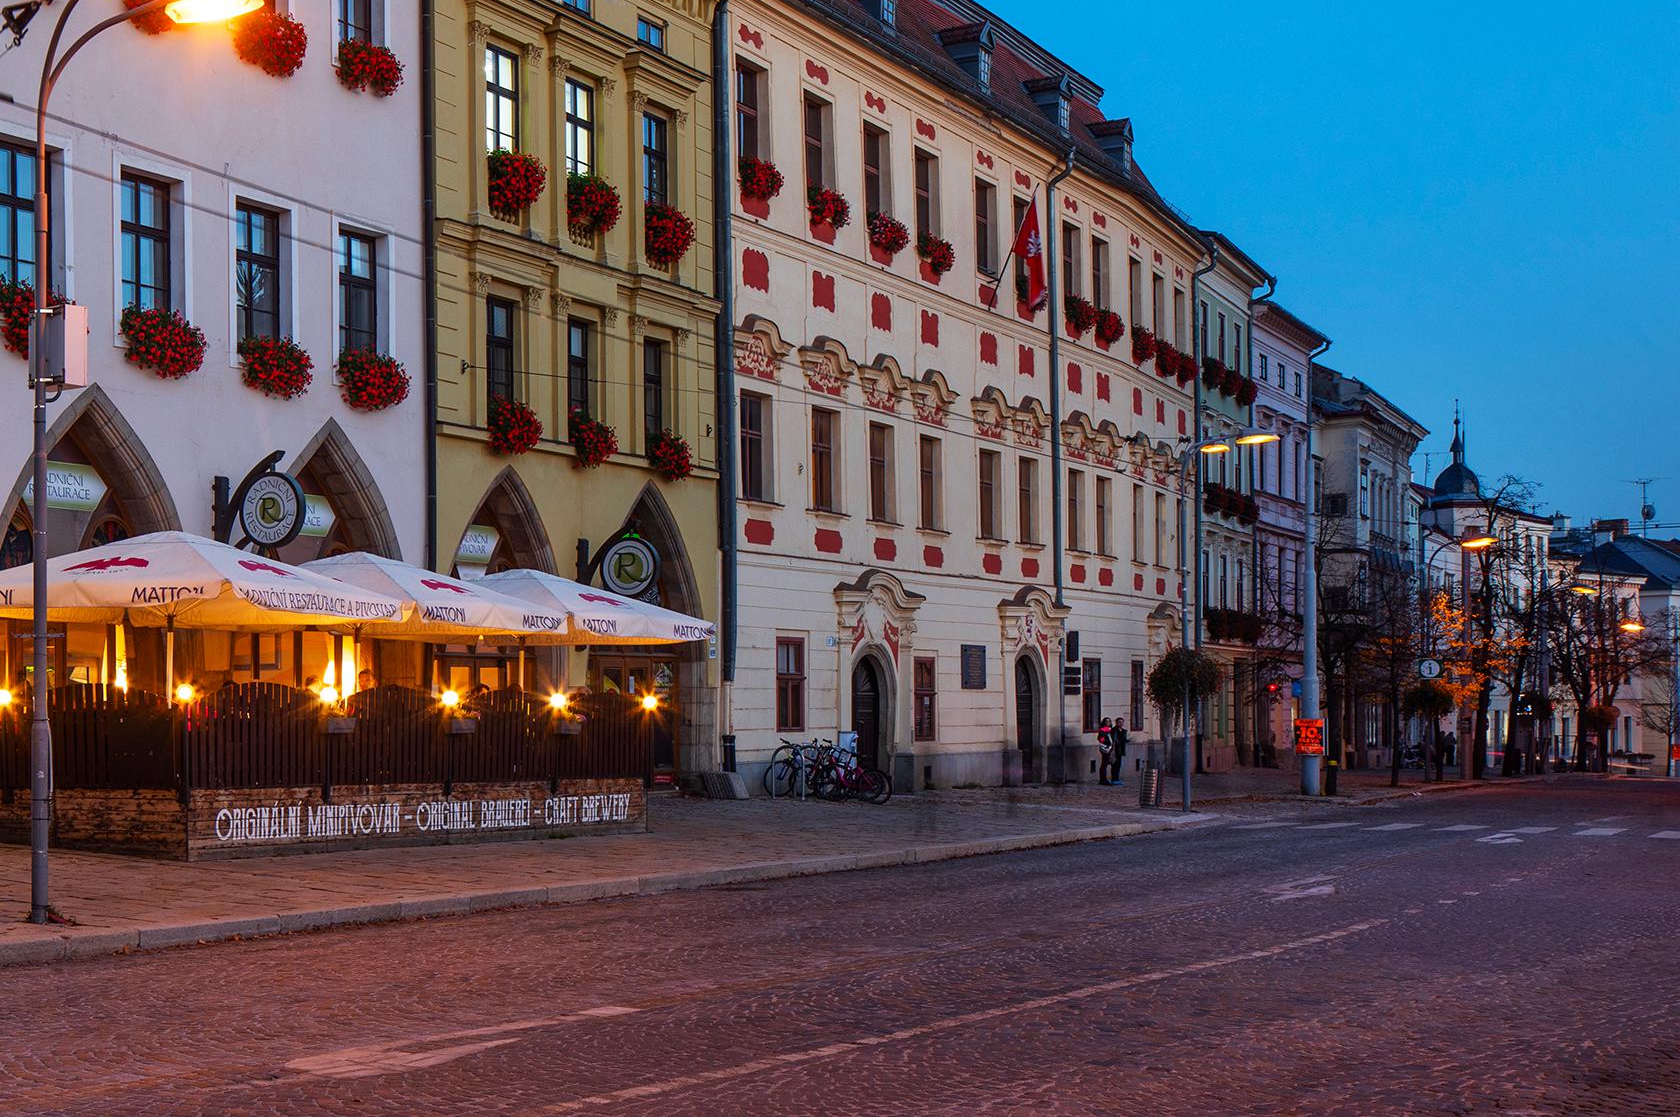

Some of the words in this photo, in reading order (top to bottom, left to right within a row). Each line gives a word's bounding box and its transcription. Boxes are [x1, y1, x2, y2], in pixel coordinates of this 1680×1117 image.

[245, 510, 295, 542] RESTAURACE
[422, 605, 466, 623] MATTONI
[215, 800, 304, 841] ORIGINÁLNÍ
[307, 802, 400, 837] MINIPIVOVAR
[416, 801, 476, 831] ORIGINAL
[480, 799, 531, 829] BRAUEREI
[544, 796, 579, 825] CRAFT
[581, 793, 631, 823] BREWERY
